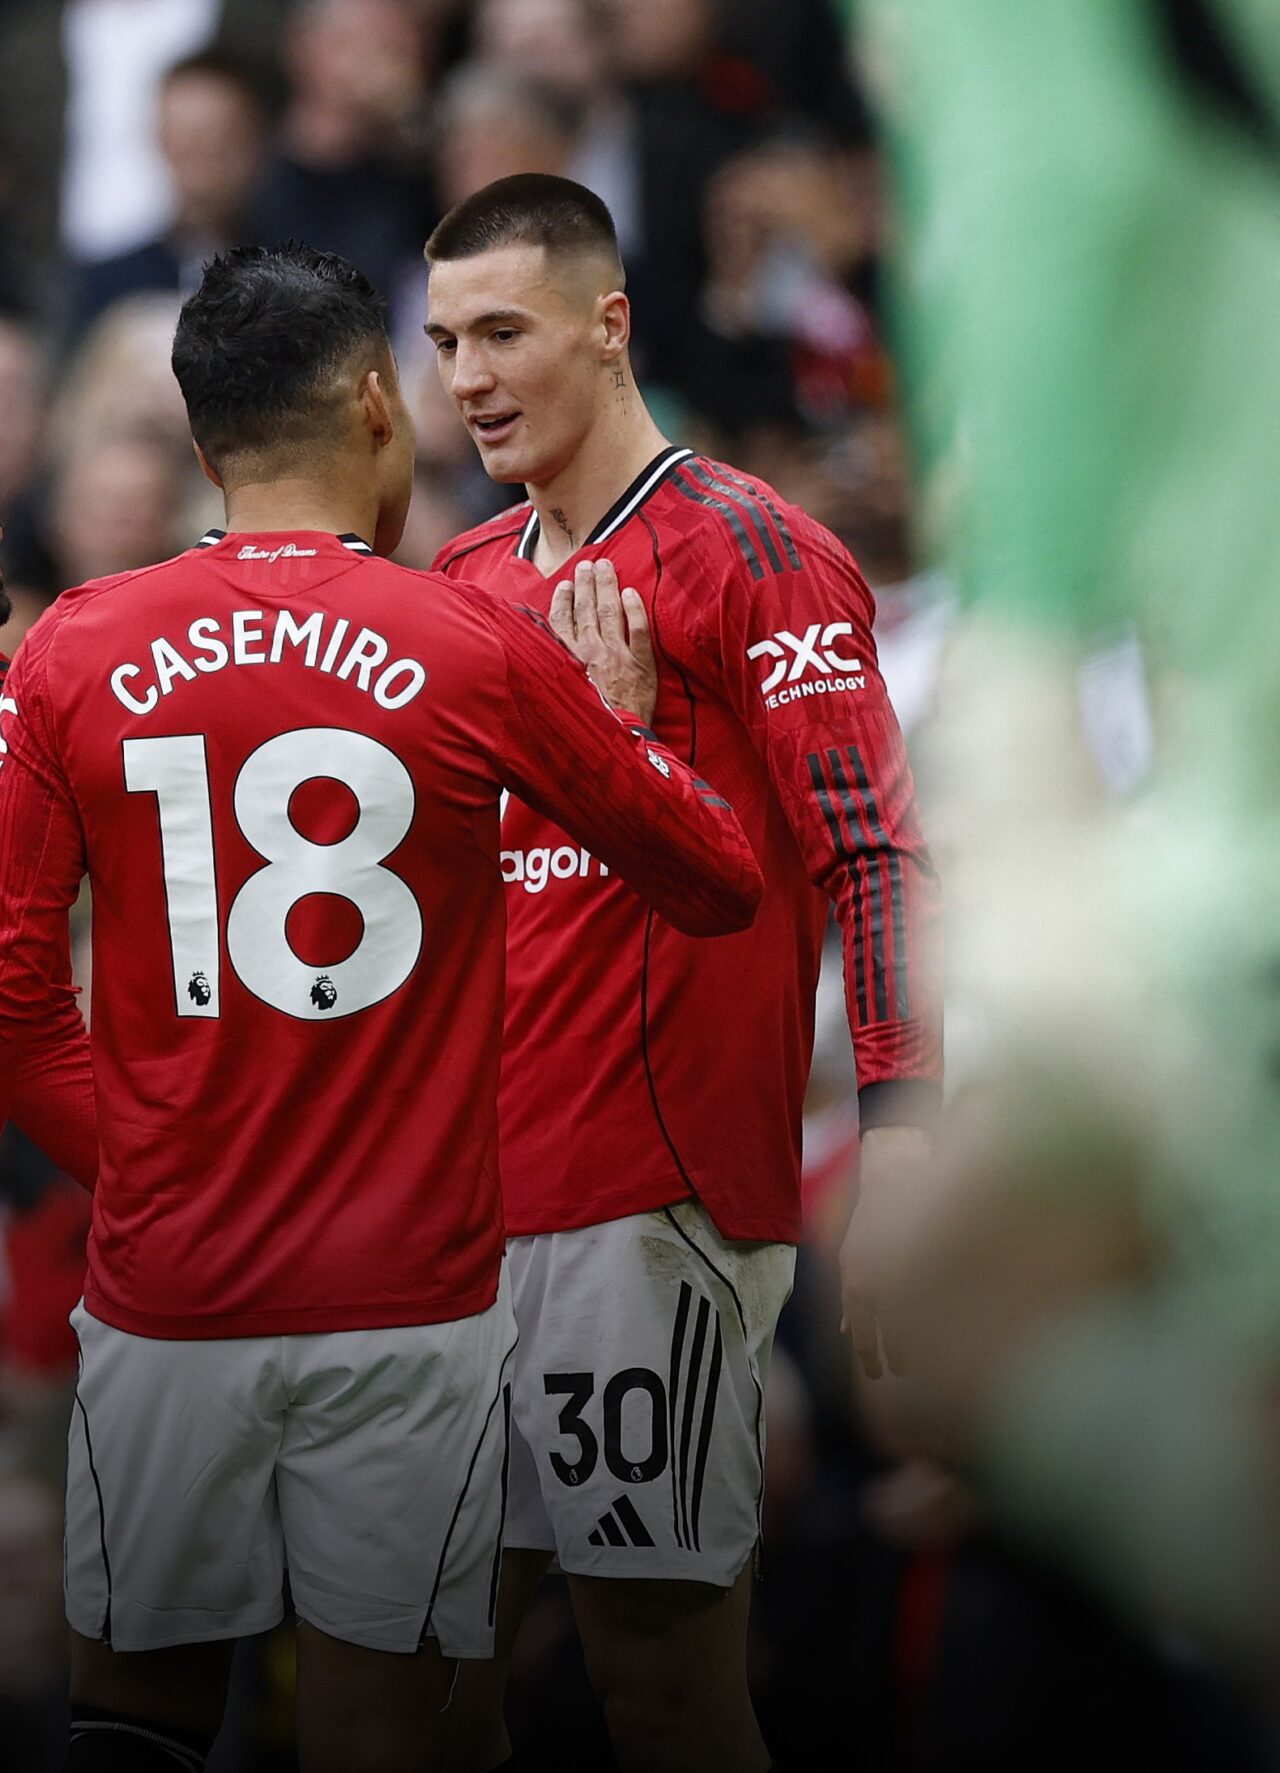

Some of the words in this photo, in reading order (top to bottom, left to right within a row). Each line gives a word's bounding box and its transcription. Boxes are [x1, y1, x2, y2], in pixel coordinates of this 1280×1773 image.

[267, 545, 285, 563] of
[109, 609, 427, 716] CASEMIRO
[746, 621, 862, 695] DXC
[122, 725, 425, 1022] 18
[543, 1367, 669, 1487] 30
